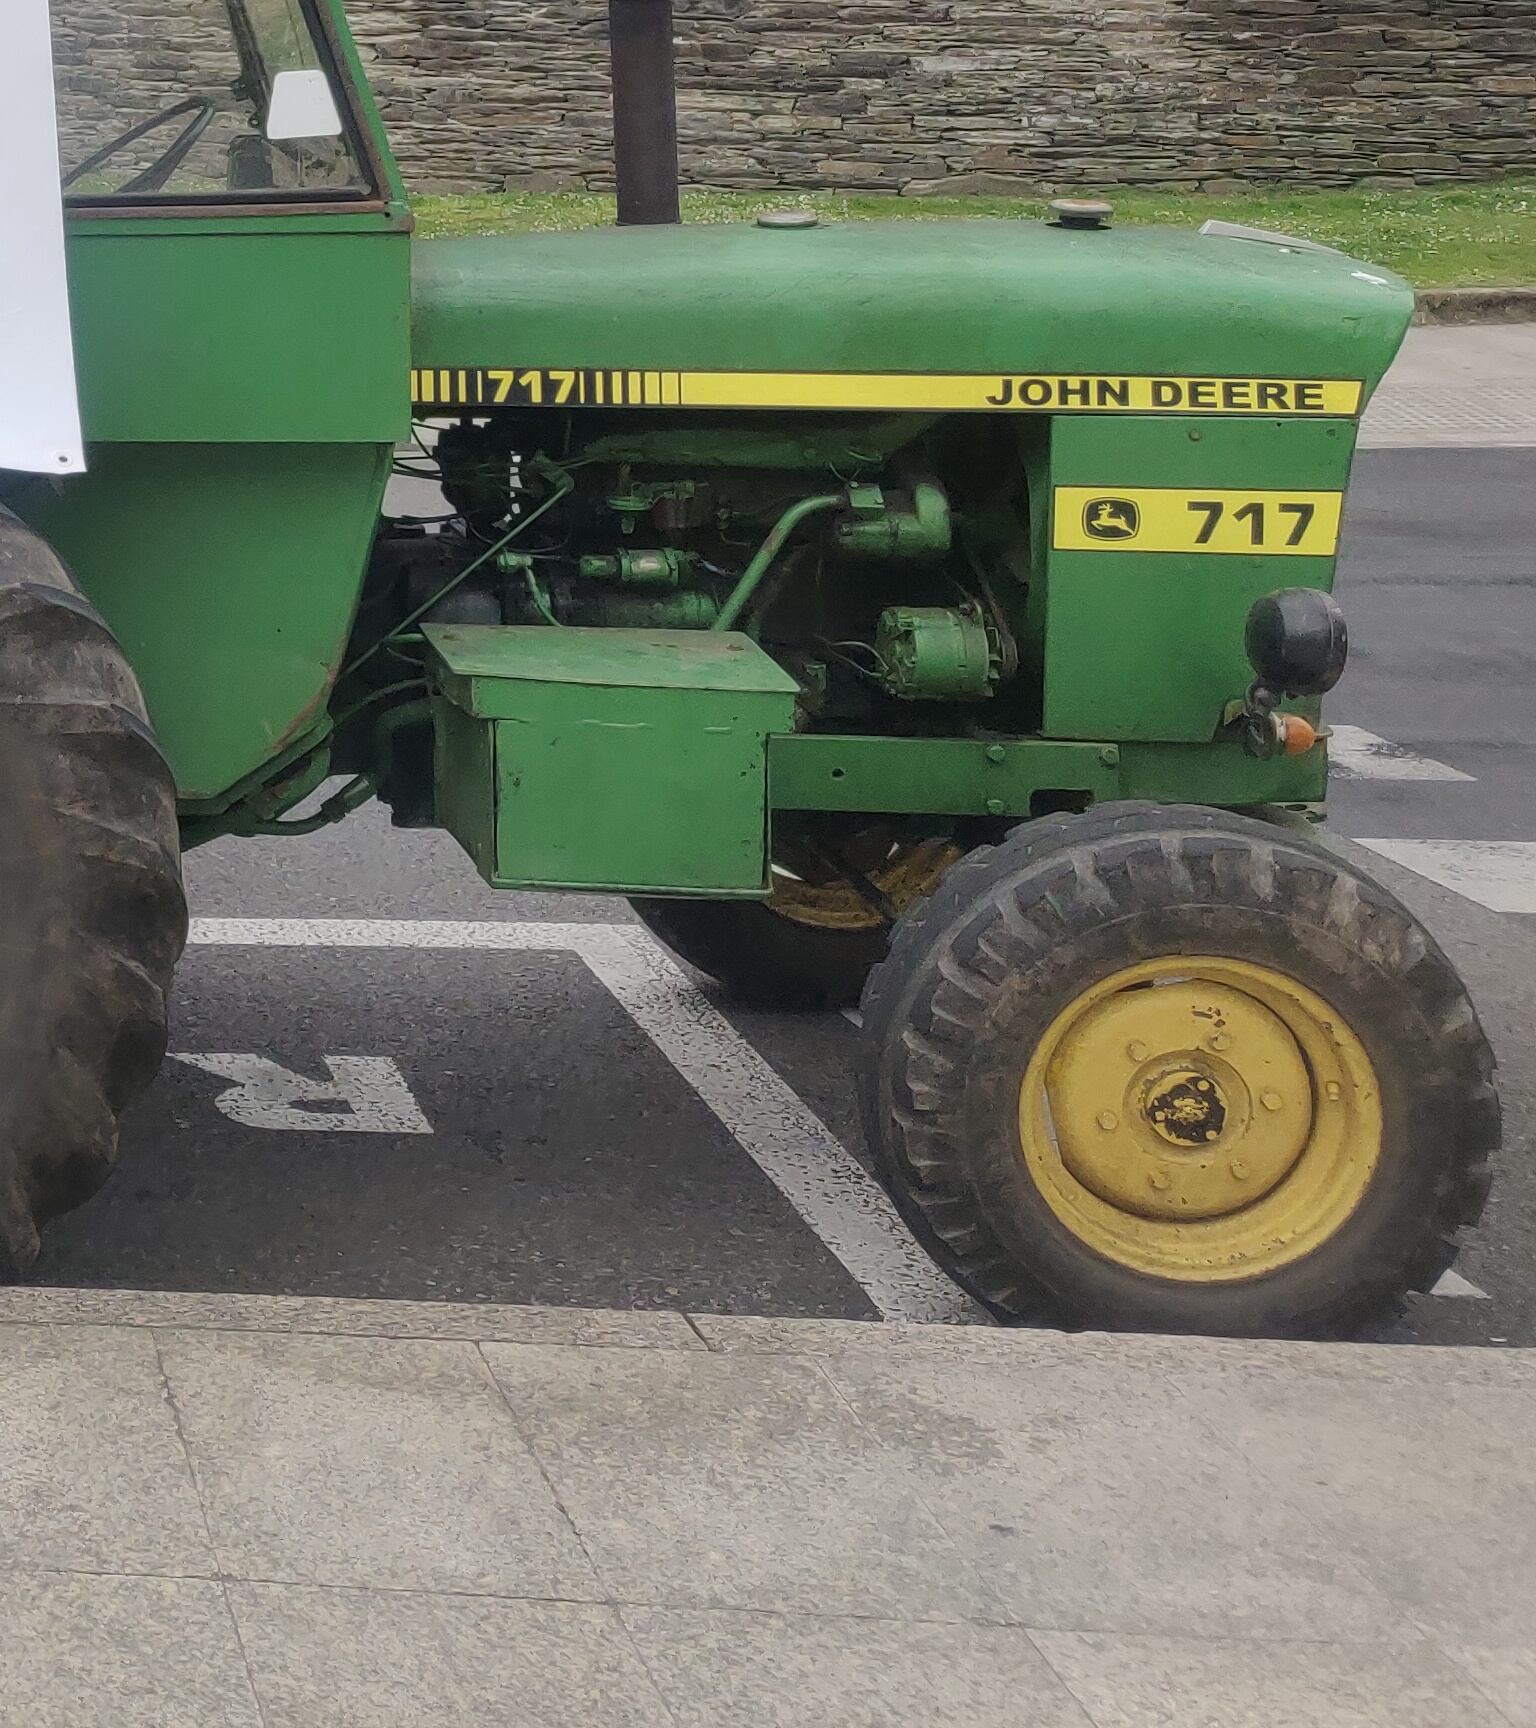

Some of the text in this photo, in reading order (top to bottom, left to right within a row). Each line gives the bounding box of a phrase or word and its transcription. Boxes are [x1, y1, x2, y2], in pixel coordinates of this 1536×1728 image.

[487, 370, 575, 403] 717
[985, 378, 1325, 411] JOHN DEERE
[1187, 501, 1315, 546] 717
